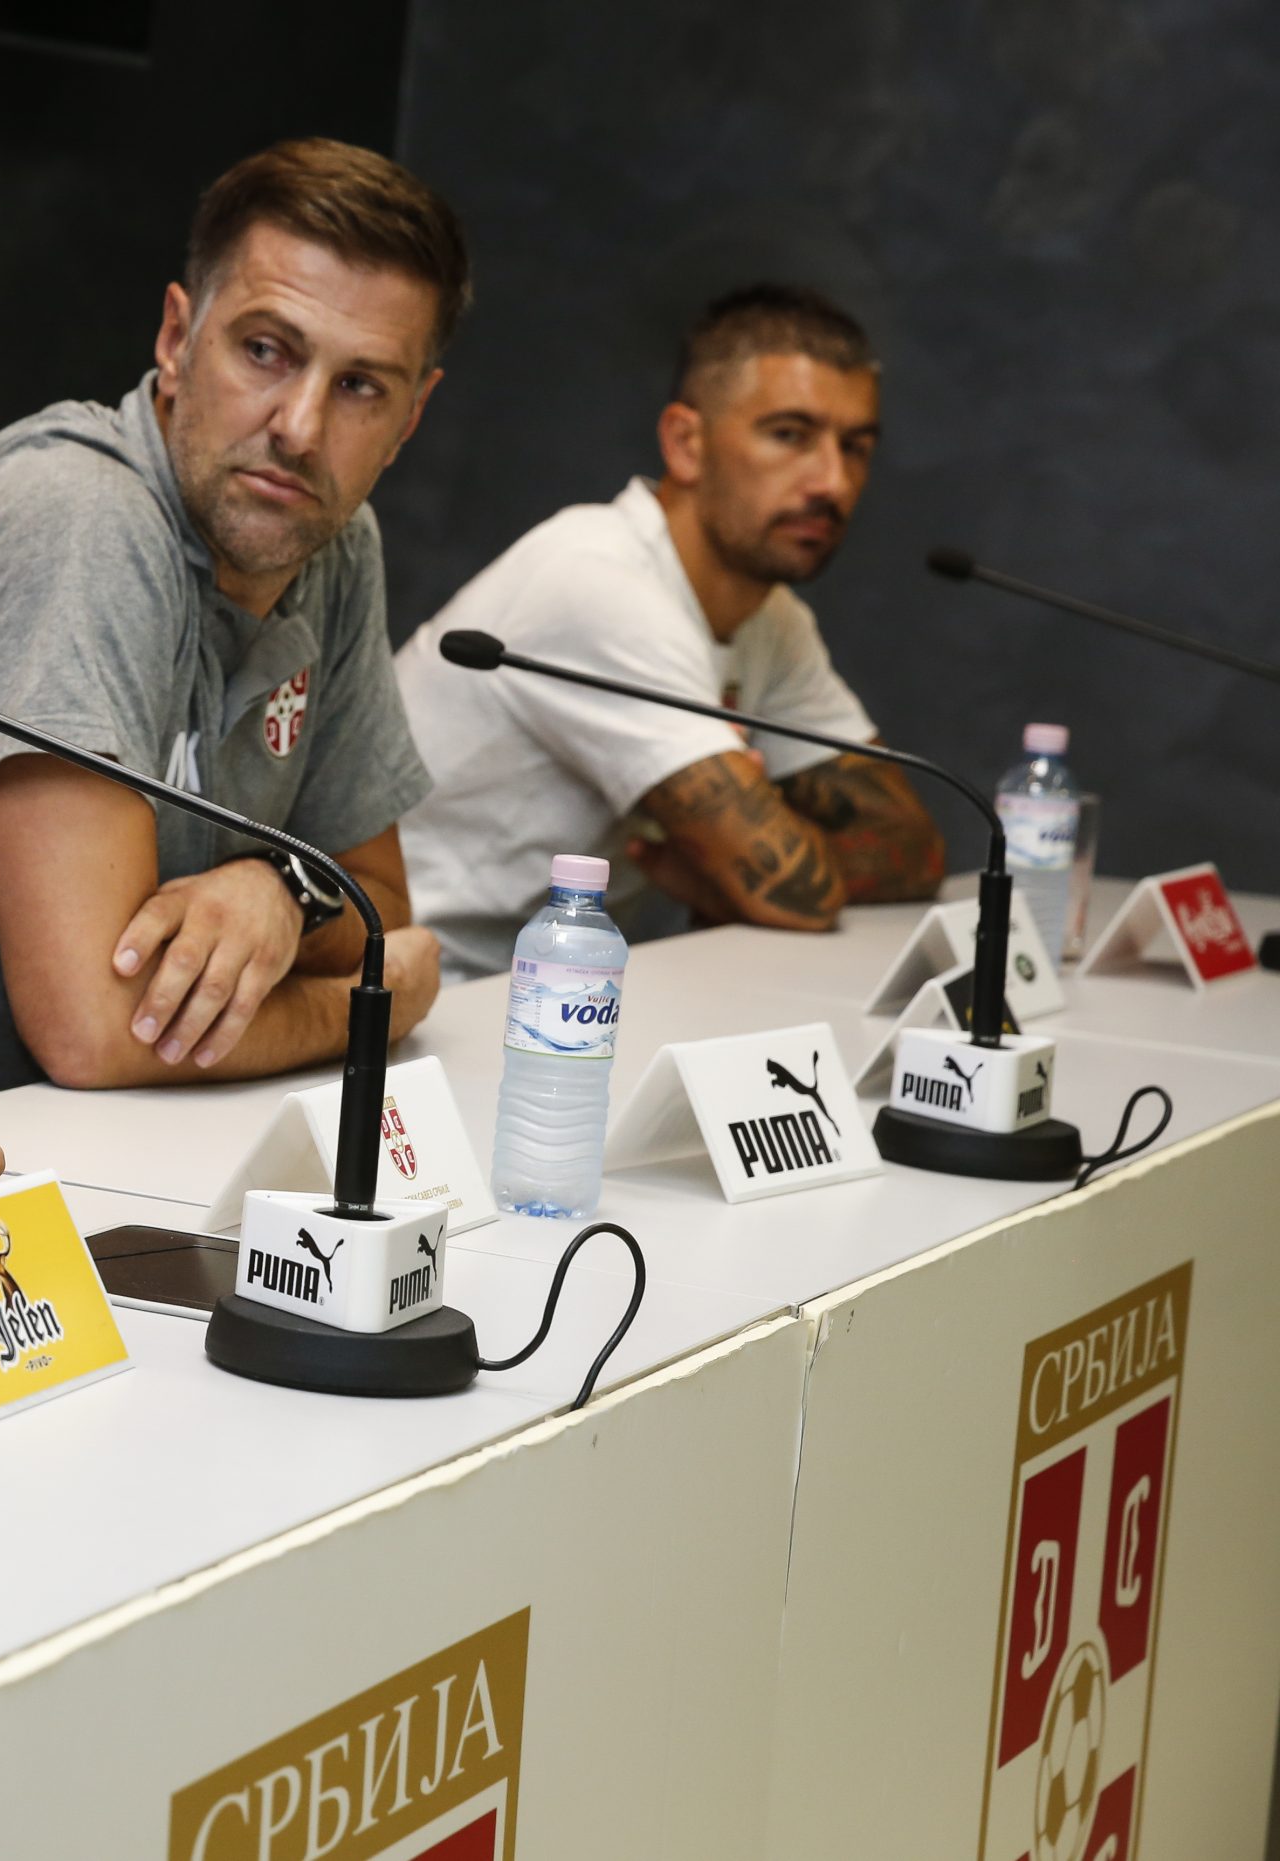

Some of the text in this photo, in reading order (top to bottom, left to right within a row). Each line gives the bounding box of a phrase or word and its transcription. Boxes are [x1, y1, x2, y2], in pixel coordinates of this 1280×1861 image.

[901, 1072, 962, 1112] PUMA
[729, 1110, 833, 1178] PUMA
[247, 1248, 320, 1304] PUMA
[389, 1265, 431, 1314] PUMA
[1029, 1292, 1177, 1435] СРБИЈА
[189, 1659, 504, 1861] СРБИЈА
